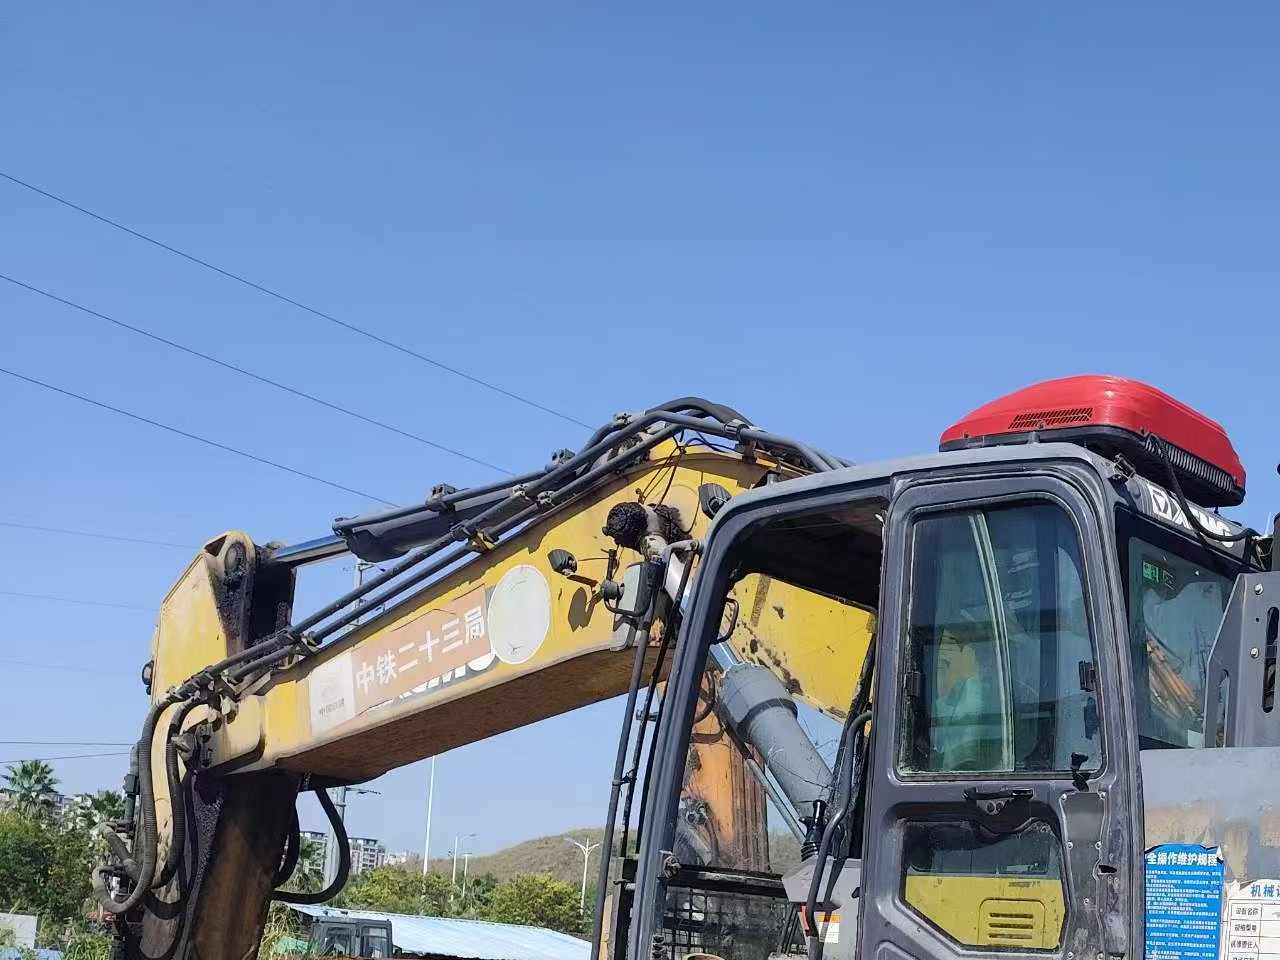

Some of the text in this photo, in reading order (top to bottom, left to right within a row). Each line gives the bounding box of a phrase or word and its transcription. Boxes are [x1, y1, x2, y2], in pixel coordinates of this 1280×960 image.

[355, 605, 487, 696] 中铁二十三局
